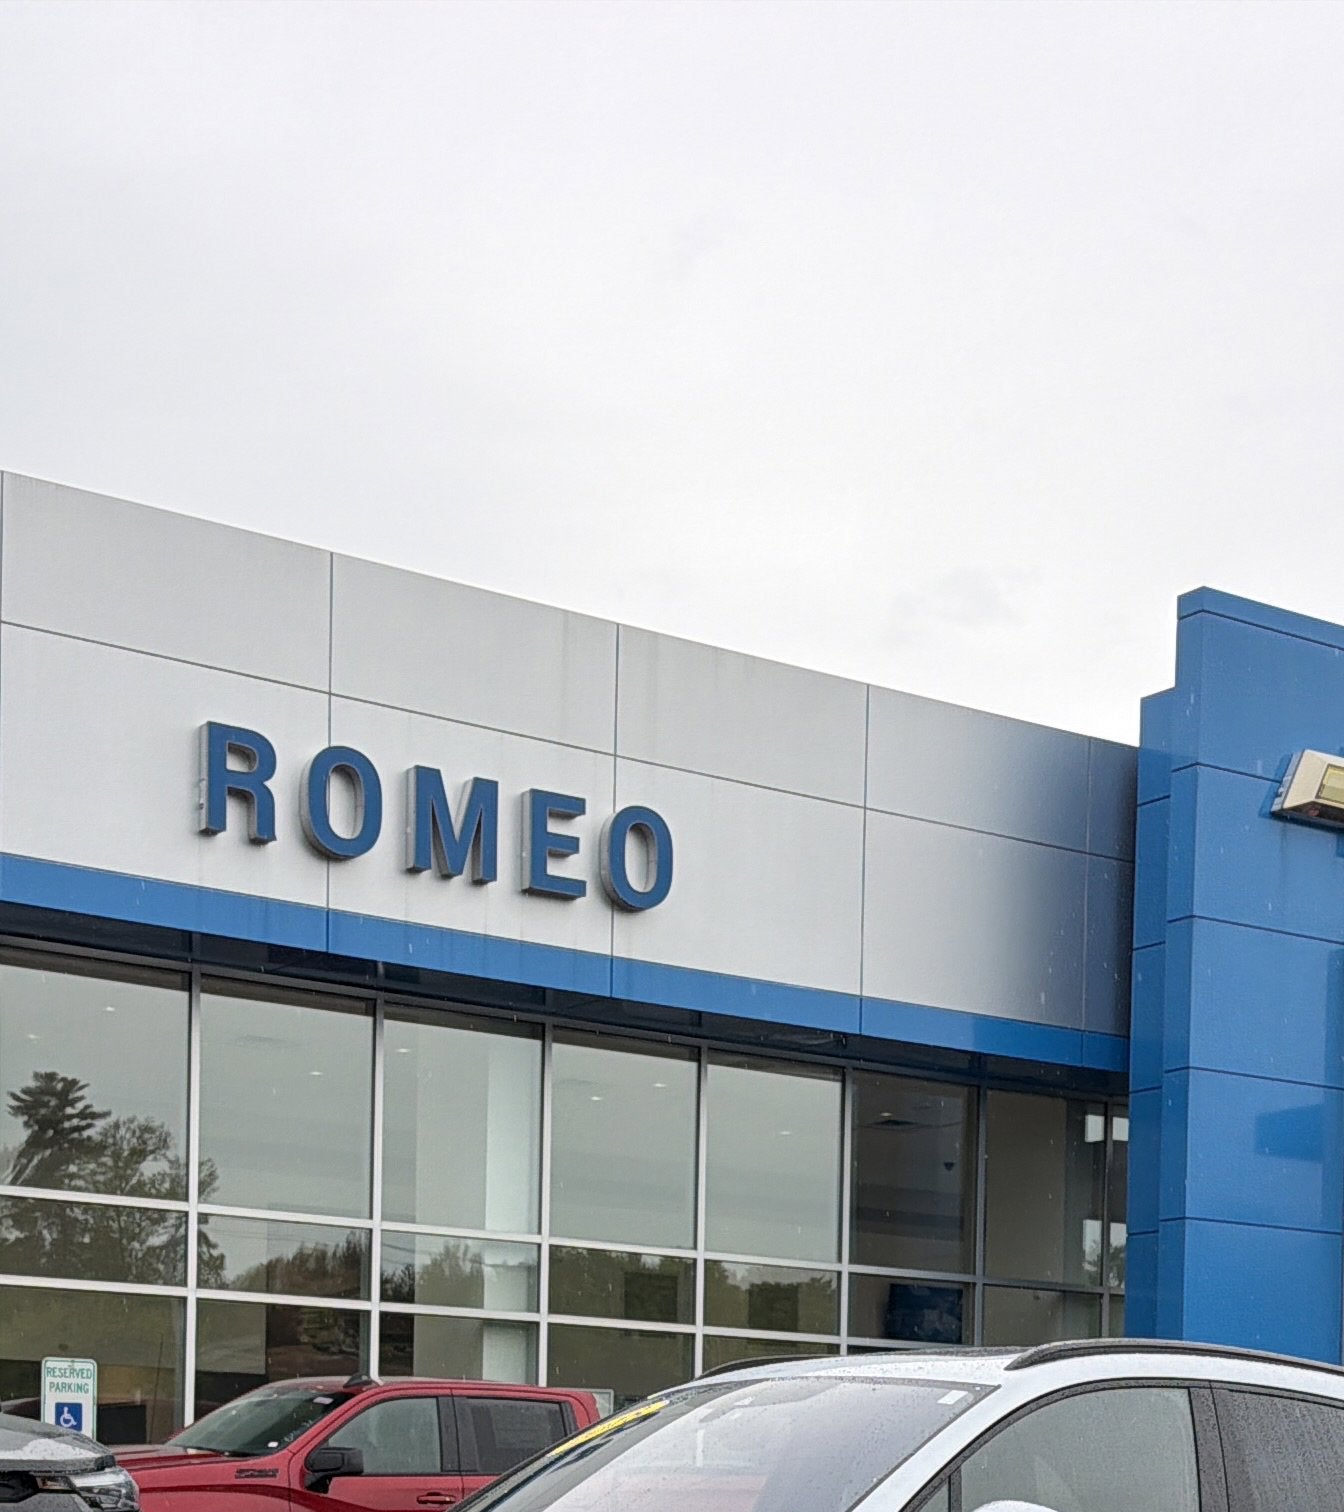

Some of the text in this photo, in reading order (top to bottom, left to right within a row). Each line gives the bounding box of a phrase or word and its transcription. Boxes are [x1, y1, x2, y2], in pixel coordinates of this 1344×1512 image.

[197, 720, 674, 912] ROMEO
[46, 1366, 92, 1379] RESERVED
[49, 1382, 89, 1393] PARKING
